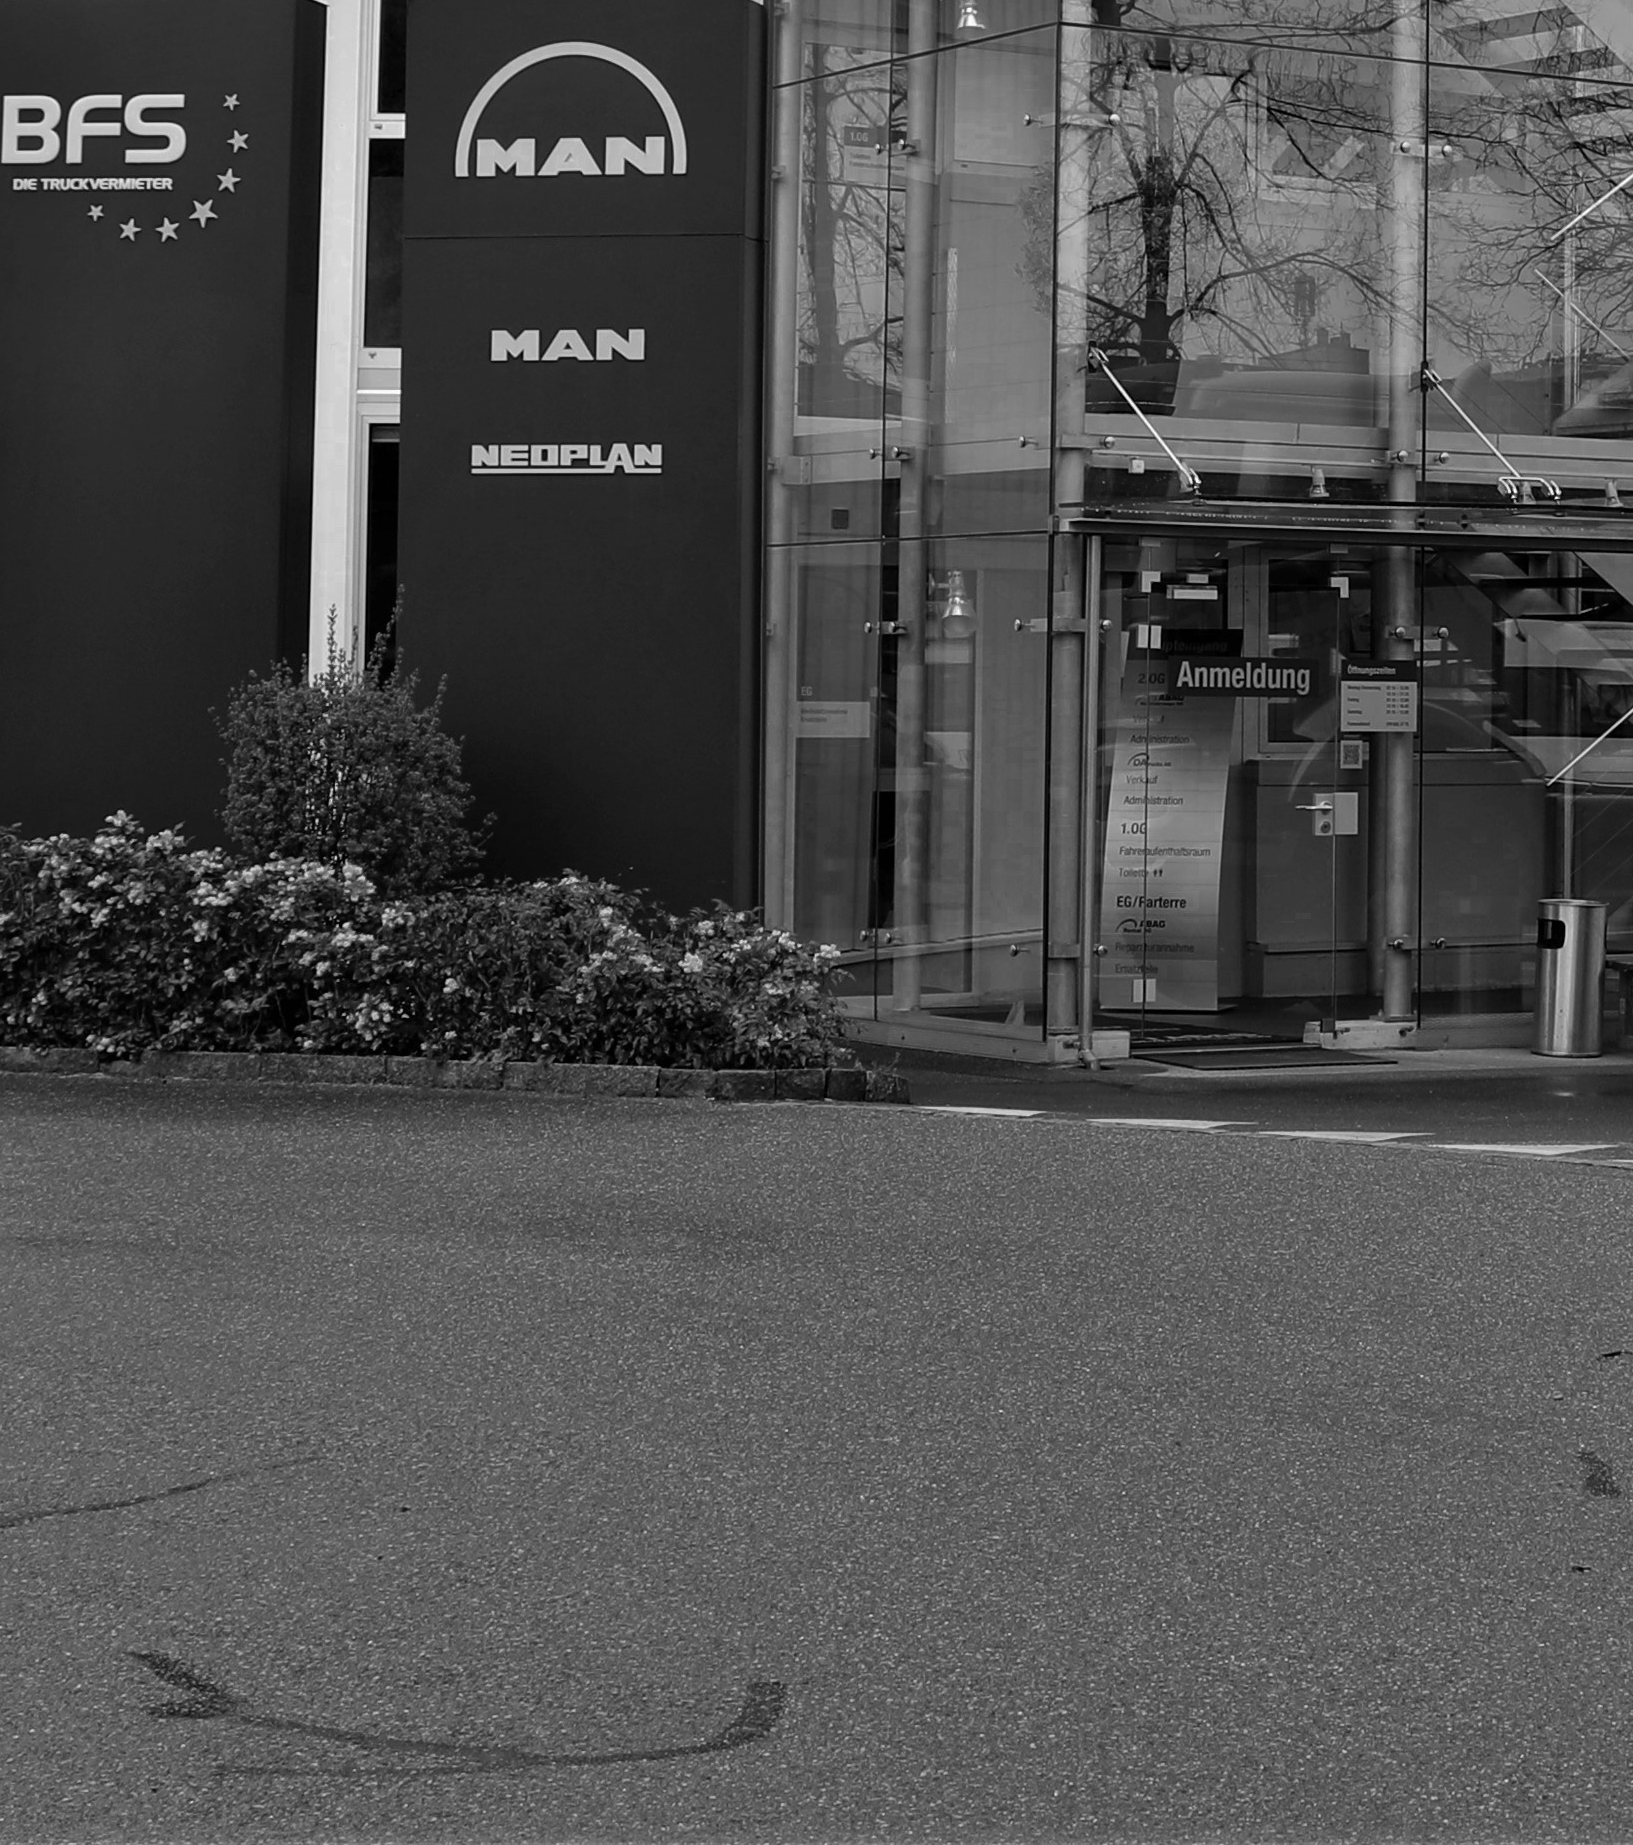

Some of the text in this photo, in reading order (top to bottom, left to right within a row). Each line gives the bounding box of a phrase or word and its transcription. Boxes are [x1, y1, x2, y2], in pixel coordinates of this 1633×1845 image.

[0, 93, 187, 165] BFS
[475, 136, 666, 178] MAN
[12, 177, 38, 191] DIE
[490, 328, 646, 362] MAN
[471, 443, 663, 475] NEOPLAN
[1176, 660, 1311, 696] Anmeldung
